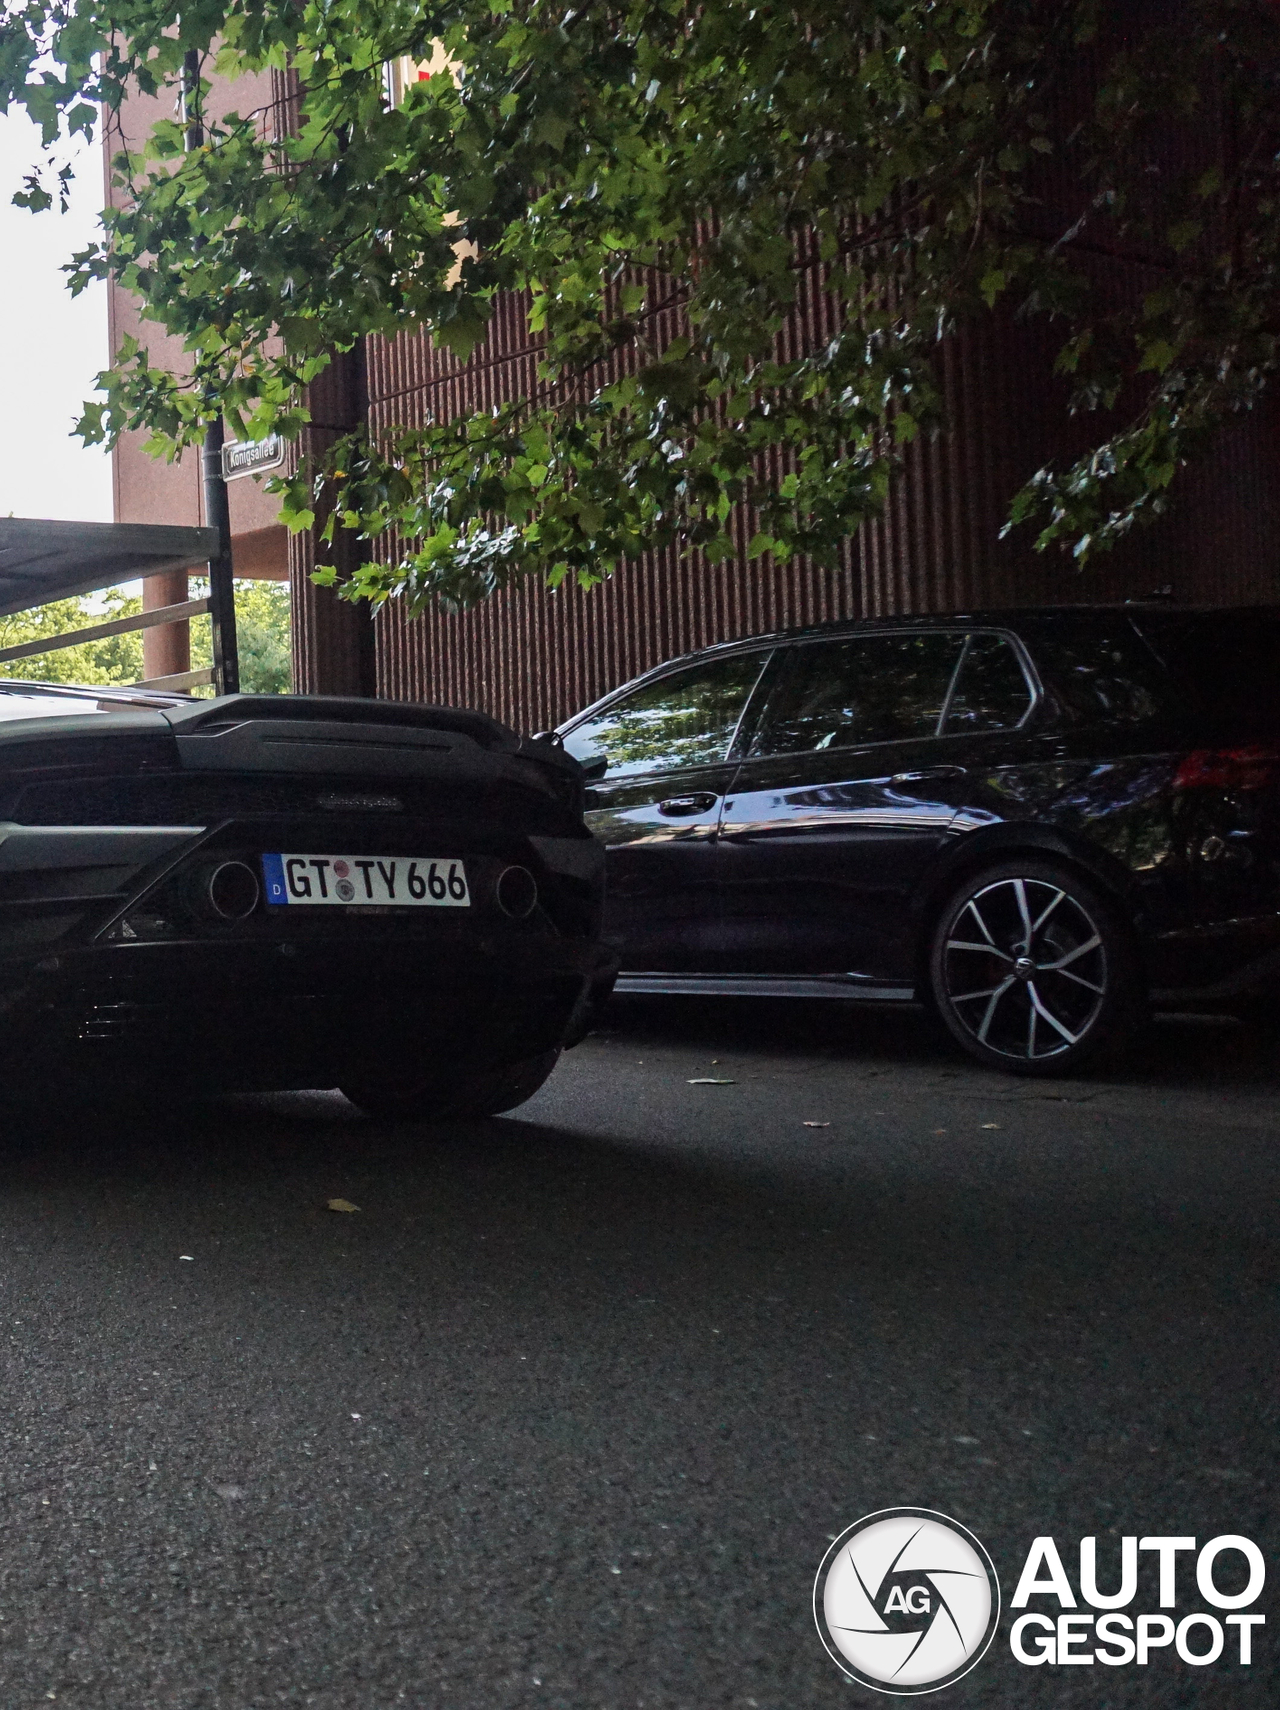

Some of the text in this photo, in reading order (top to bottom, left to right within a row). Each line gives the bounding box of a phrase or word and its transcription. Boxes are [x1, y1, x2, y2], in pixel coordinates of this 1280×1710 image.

[273, 884, 281, 895] D
[286, 858, 466, 901] GT TY 666
